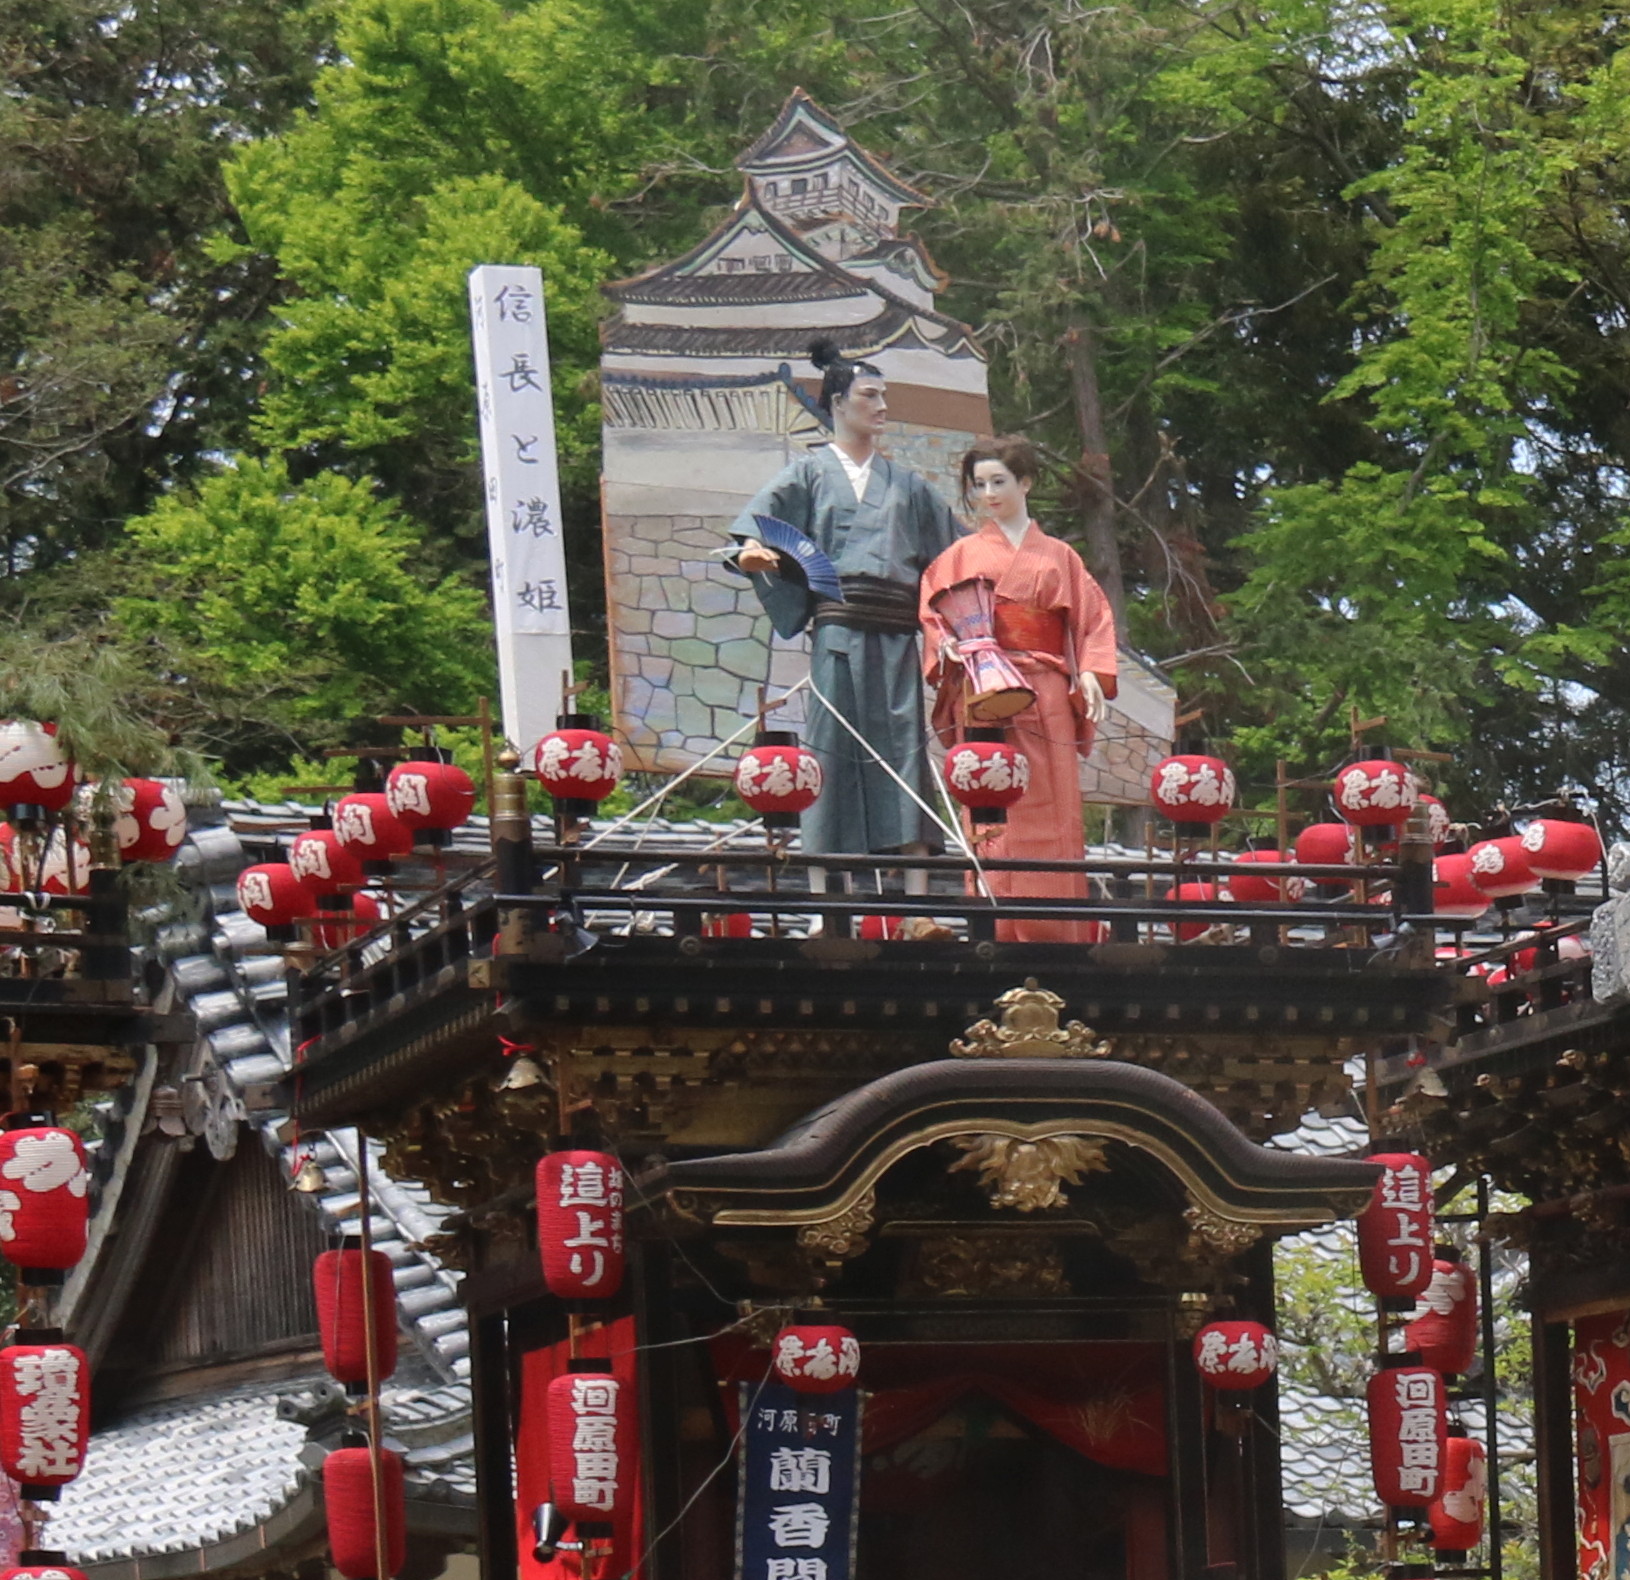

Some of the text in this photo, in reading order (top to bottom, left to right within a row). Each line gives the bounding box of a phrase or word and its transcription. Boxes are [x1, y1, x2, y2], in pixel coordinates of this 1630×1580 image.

[494, 285, 562, 613] 信長と濃姫
